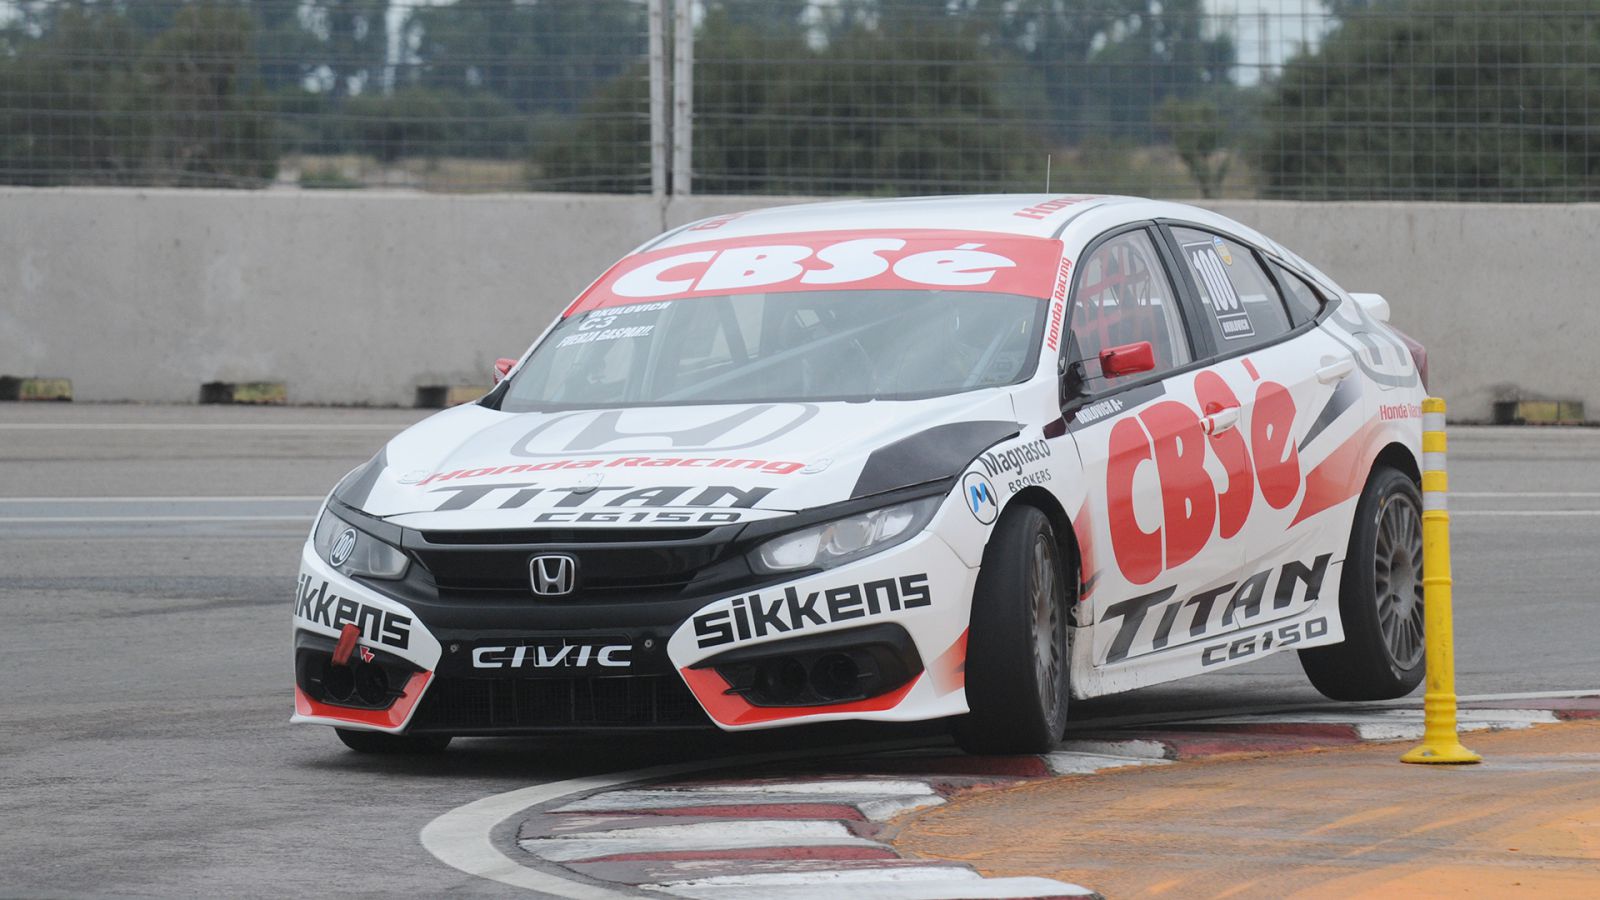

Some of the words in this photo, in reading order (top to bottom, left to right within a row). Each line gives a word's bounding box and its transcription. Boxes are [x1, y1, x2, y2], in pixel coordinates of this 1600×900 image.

[611, 238, 1017, 298] CBSé
[1054, 257, 1073, 301] Racing
[1192, 248, 1238, 311] 100
[578, 315, 618, 331] C3
[588, 301, 673, 319] OKULOVICH
[1047, 300, 1063, 352] Honda
[1075, 401, 1115, 425] OKULOVICH
[1379, 403, 1409, 421] Honda
[416, 459, 604, 486] Honda
[604, 457, 807, 475] Racing
[977, 439, 1051, 478] Magnasco
[1106, 358, 1301, 585] CBSé
[426, 483, 778, 512] TITAN
[1008, 468, 1052, 494] BROKERS
[533, 512, 743, 523] CG150
[332, 533, 354, 561] 100
[294, 573, 412, 650] ikkens
[693, 573, 932, 649] sikkens
[1099, 552, 1333, 664] TITAN
[472, 644, 633, 668] CIVIC
[1201, 616, 1328, 667] CG150
